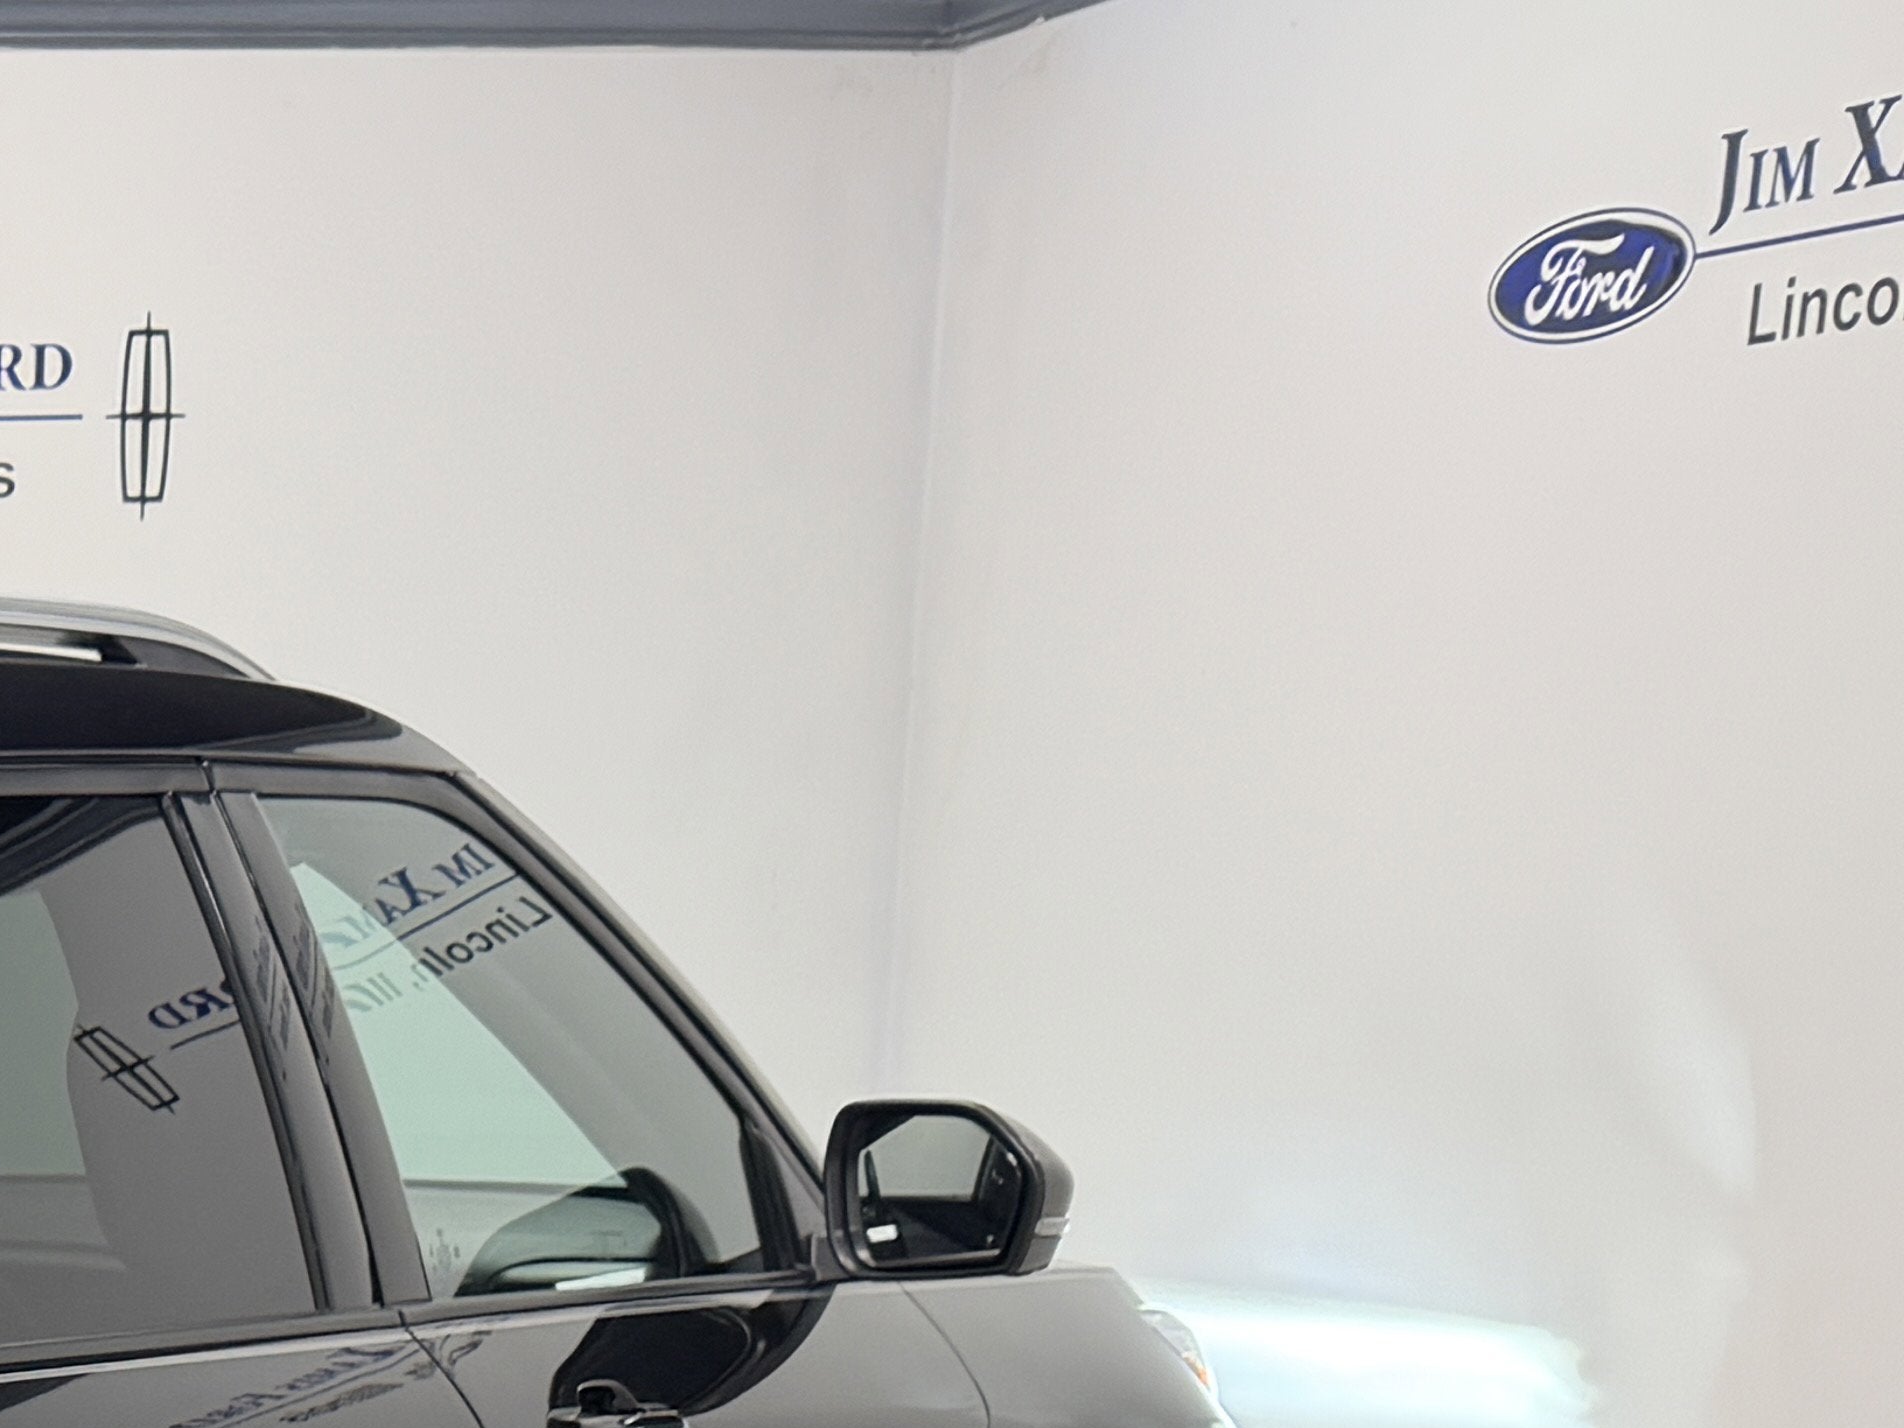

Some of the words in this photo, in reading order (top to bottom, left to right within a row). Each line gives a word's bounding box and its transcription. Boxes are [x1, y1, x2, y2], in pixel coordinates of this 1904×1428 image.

[1708, 128, 1821, 236] JIM
[1523, 232, 1655, 327] Ford
[1747, 276, 1904, 346] Linco
